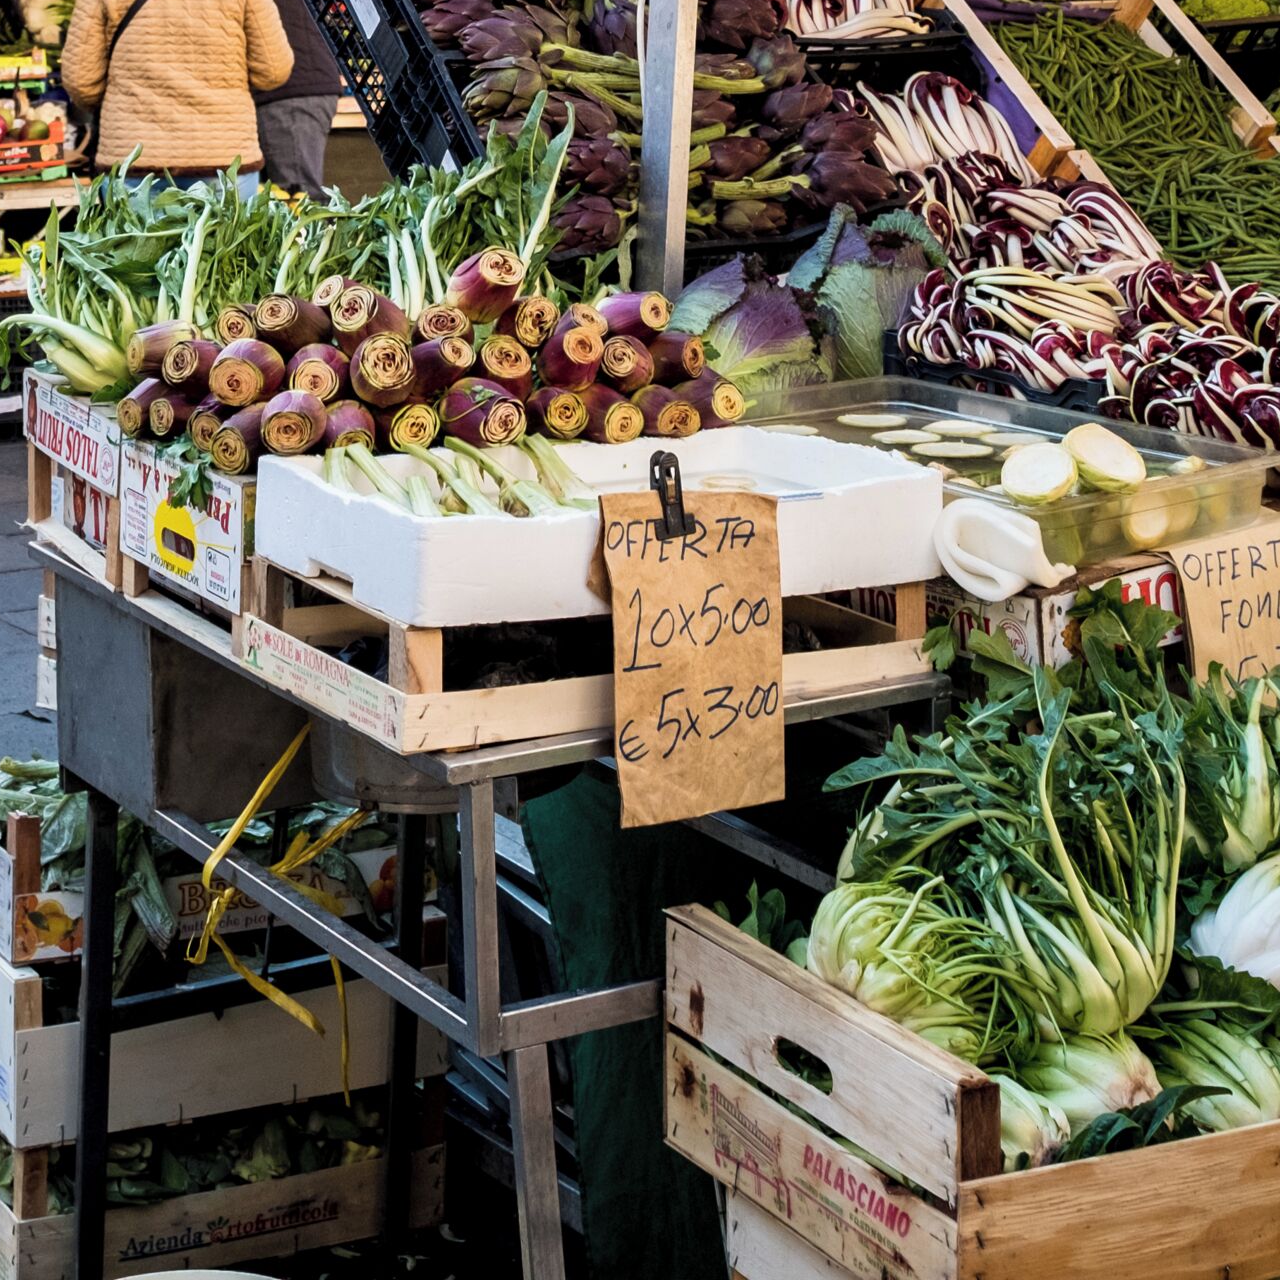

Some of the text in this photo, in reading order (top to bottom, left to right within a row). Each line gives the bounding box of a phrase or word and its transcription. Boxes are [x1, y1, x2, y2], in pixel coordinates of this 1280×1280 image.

[37, 407, 66, 457] FRUIT
[64, 428, 100, 479] TALOS
[606, 516, 756, 563] OFFERTA
[271, 632, 295, 663] SOLE
[303, 647, 350, 688] ROMAGNA
[802, 1143, 913, 1239] PALASCIANO
[121, 1227, 204, 1258] Azienda
